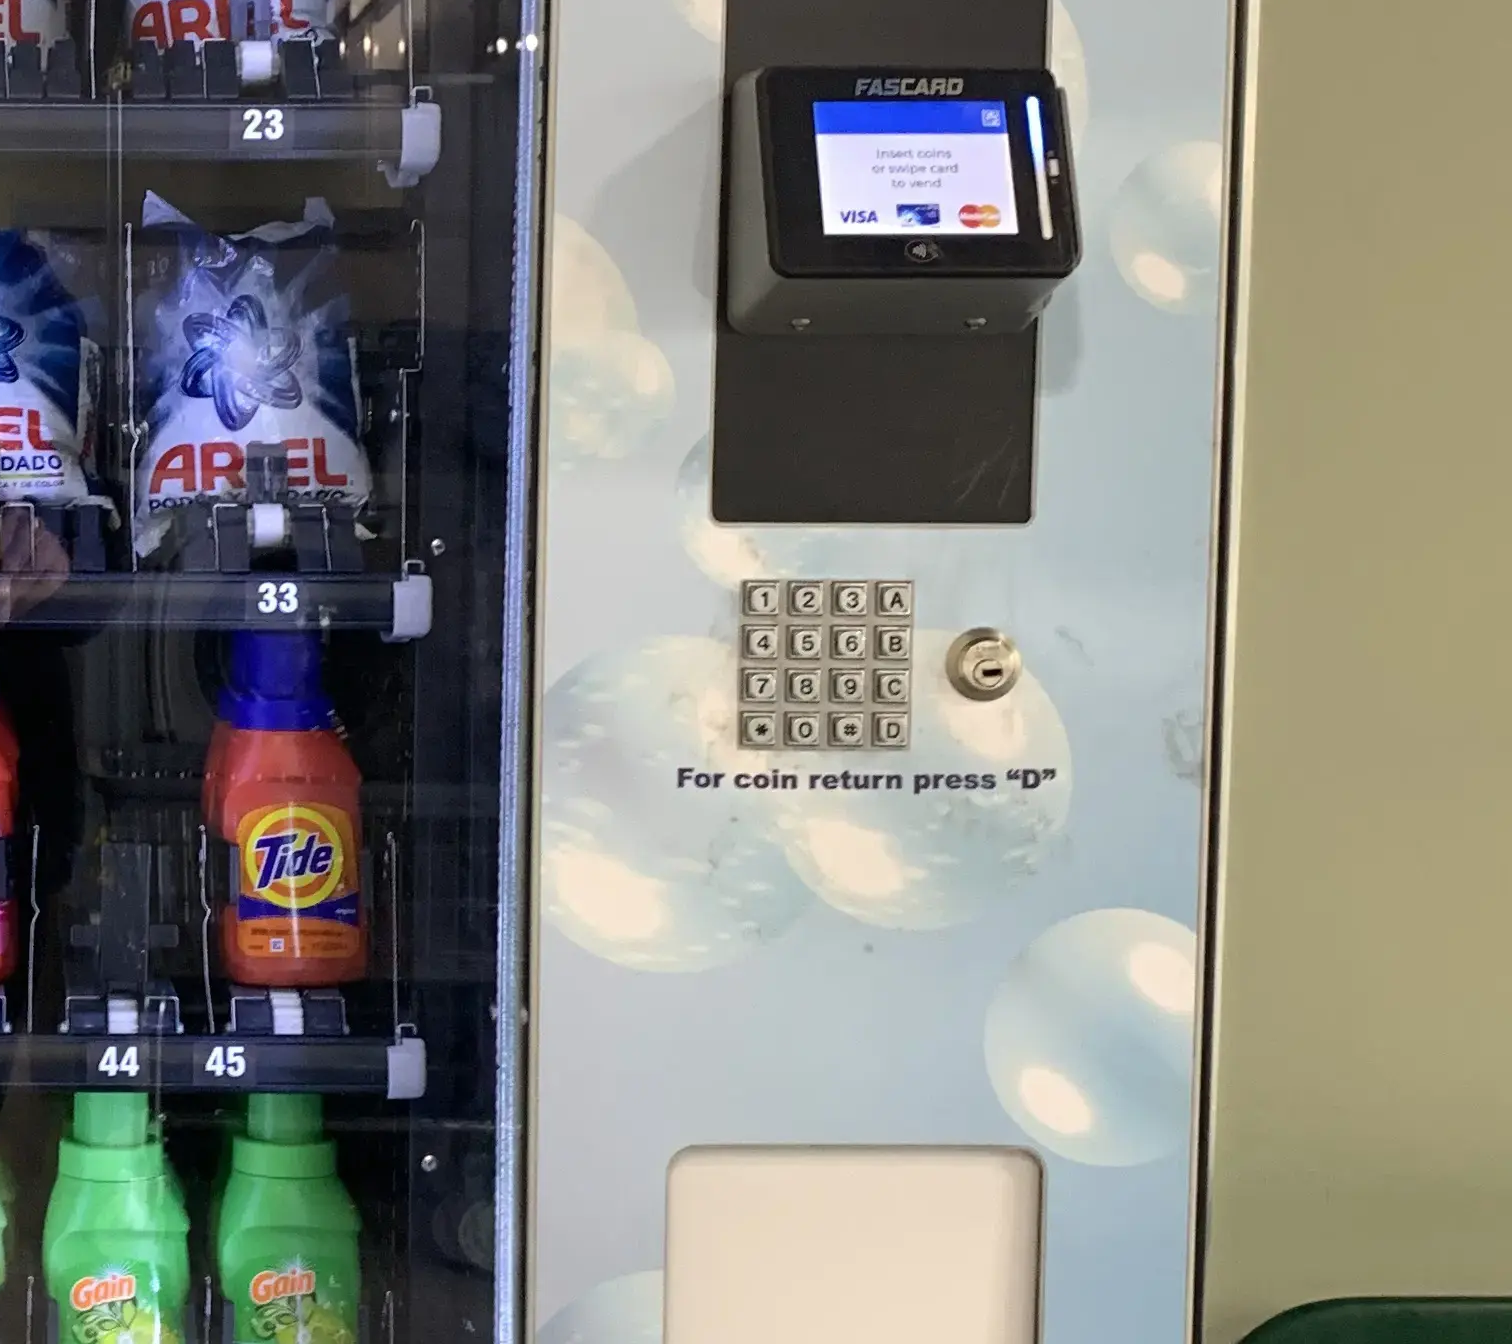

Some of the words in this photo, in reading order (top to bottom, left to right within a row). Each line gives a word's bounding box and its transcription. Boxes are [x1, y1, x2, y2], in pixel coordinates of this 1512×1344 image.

[854, 77, 965, 96] FASCARD
[243, 108, 284, 140] 23
[876, 149, 914, 160] Insert
[917, 149, 952, 160] coins
[872, 165, 885, 174] or
[889, 163, 926, 176] swipe
[929, 163, 959, 174] card
[891, 178, 906, 189] to
[909, 178, 942, 189] vend
[840, 210, 879, 224] VISA
[0, 455, 64, 472] DADO
[149, 437, 348, 495] AREL
[258, 582, 298, 613] 33
[761, 591, 769, 607] 1
[803, 591, 815, 608] 2
[847, 591, 859, 608] 3
[890, 591, 905, 609] A
[757, 635, 769, 651] 4
[802, 635, 814, 652] 5
[845, 635, 858, 652] 6
[890, 635, 903, 653] B
[756, 678, 769, 694] 7
[800, 678, 813, 695] 8
[843, 678, 857, 695] 9
[888, 678, 902, 696] C
[887, 722, 900, 739] D
[676, 767, 726, 789] For
[733, 768, 799, 790] coin
[808, 770, 903, 790] return
[913, 770, 997, 795] press
[254, 833, 334, 892] Tide
[98, 1046, 140, 1077] 44
[205, 1046, 246, 1077] 45
[71, 1274, 136, 1311] Gain
[250, 1269, 315, 1305] Gain
